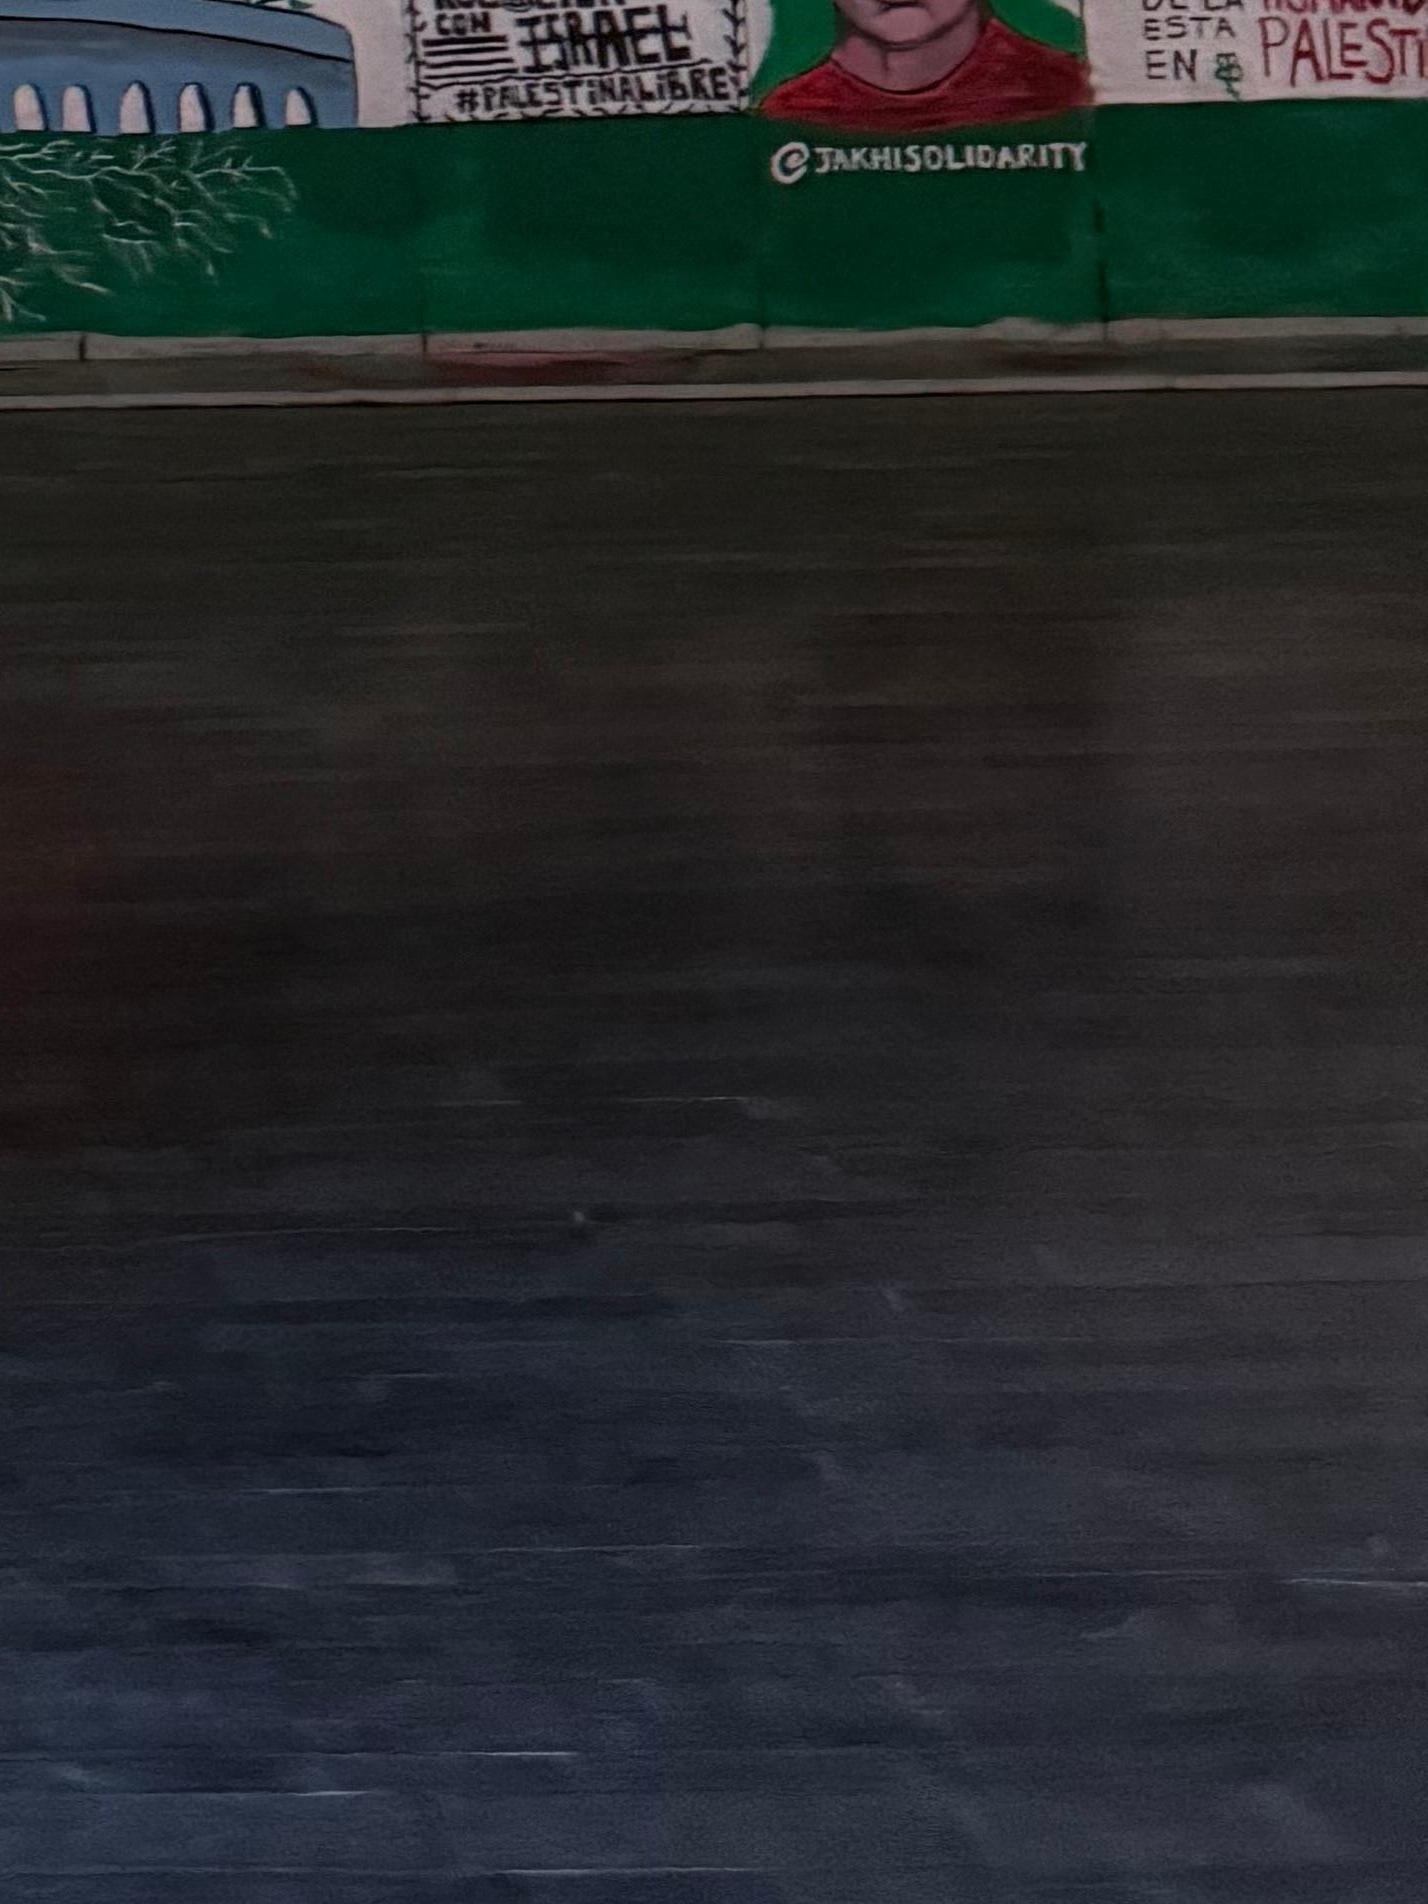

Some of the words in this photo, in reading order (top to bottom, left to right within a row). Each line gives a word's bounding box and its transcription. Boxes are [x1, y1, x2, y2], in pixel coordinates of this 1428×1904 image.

[436, 11, 491, 36] CON
[1144, 15, 1237, 41] ESTA
[1145, 48, 1198, 82] EN
